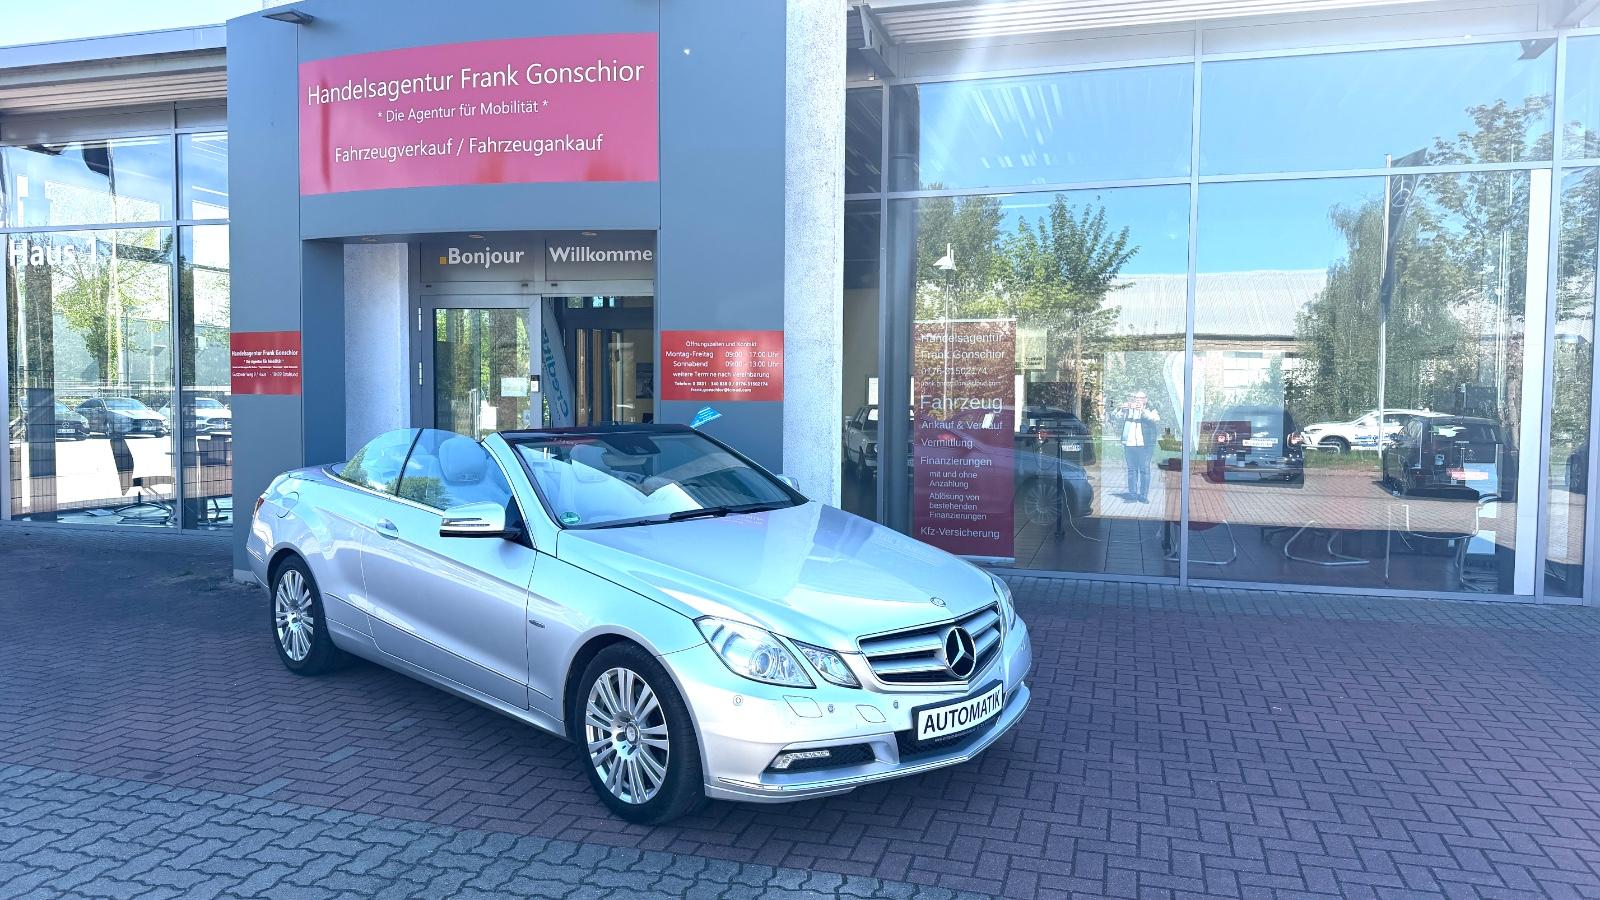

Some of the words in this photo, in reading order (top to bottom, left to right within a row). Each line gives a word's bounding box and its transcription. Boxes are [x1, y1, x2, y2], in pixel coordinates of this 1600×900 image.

[308, 73, 453, 105] Handelsagentur
[461, 64, 519, 89] Frank
[526, 59, 645, 85] Gonschior
[386, 110, 405, 123] Die
[408, 106, 456, 123] Agentur
[459, 103, 477, 116] für
[480, 100, 539, 115] Mobilität
[335, 138, 453, 162] Fahrzeugverkauf
[456, 138, 465, 157] /
[469, 133, 604, 157] Fahrzeugankauf
[9, 238, 76, 267] Haus
[448, 246, 525, 269] Bonjour
[549, 246, 653, 263] Willkomme
[921, 332, 1003, 344] Handelsagentur
[665, 350, 714, 359] Montag-Freitag
[921, 349, 950, 359] Frank
[952, 348, 1005, 359] Gonschior
[733, 371, 770, 379] Vereinbarung
[920, 394, 1003, 414] Fahrzeug
[921, 420, 955, 430] Ankauf
[956, 421, 964, 430] &
[966, 420, 1003, 430] Verauf
[921, 438, 973, 449] Vermittlung
[920, 456, 992, 467] Finanzierungen
[942, 470, 957, 478] und
[958, 471, 978, 479] ohne
[929, 480, 969, 489] Anzahlung
[929, 492, 964, 501] Ablösung
[929, 502, 978, 510] bestehenden
[929, 512, 987, 521] Finanzierungen
[920, 526, 1000, 540] Kfz-Versicherung
[923, 690, 1000, 735] AUTOMATIK
